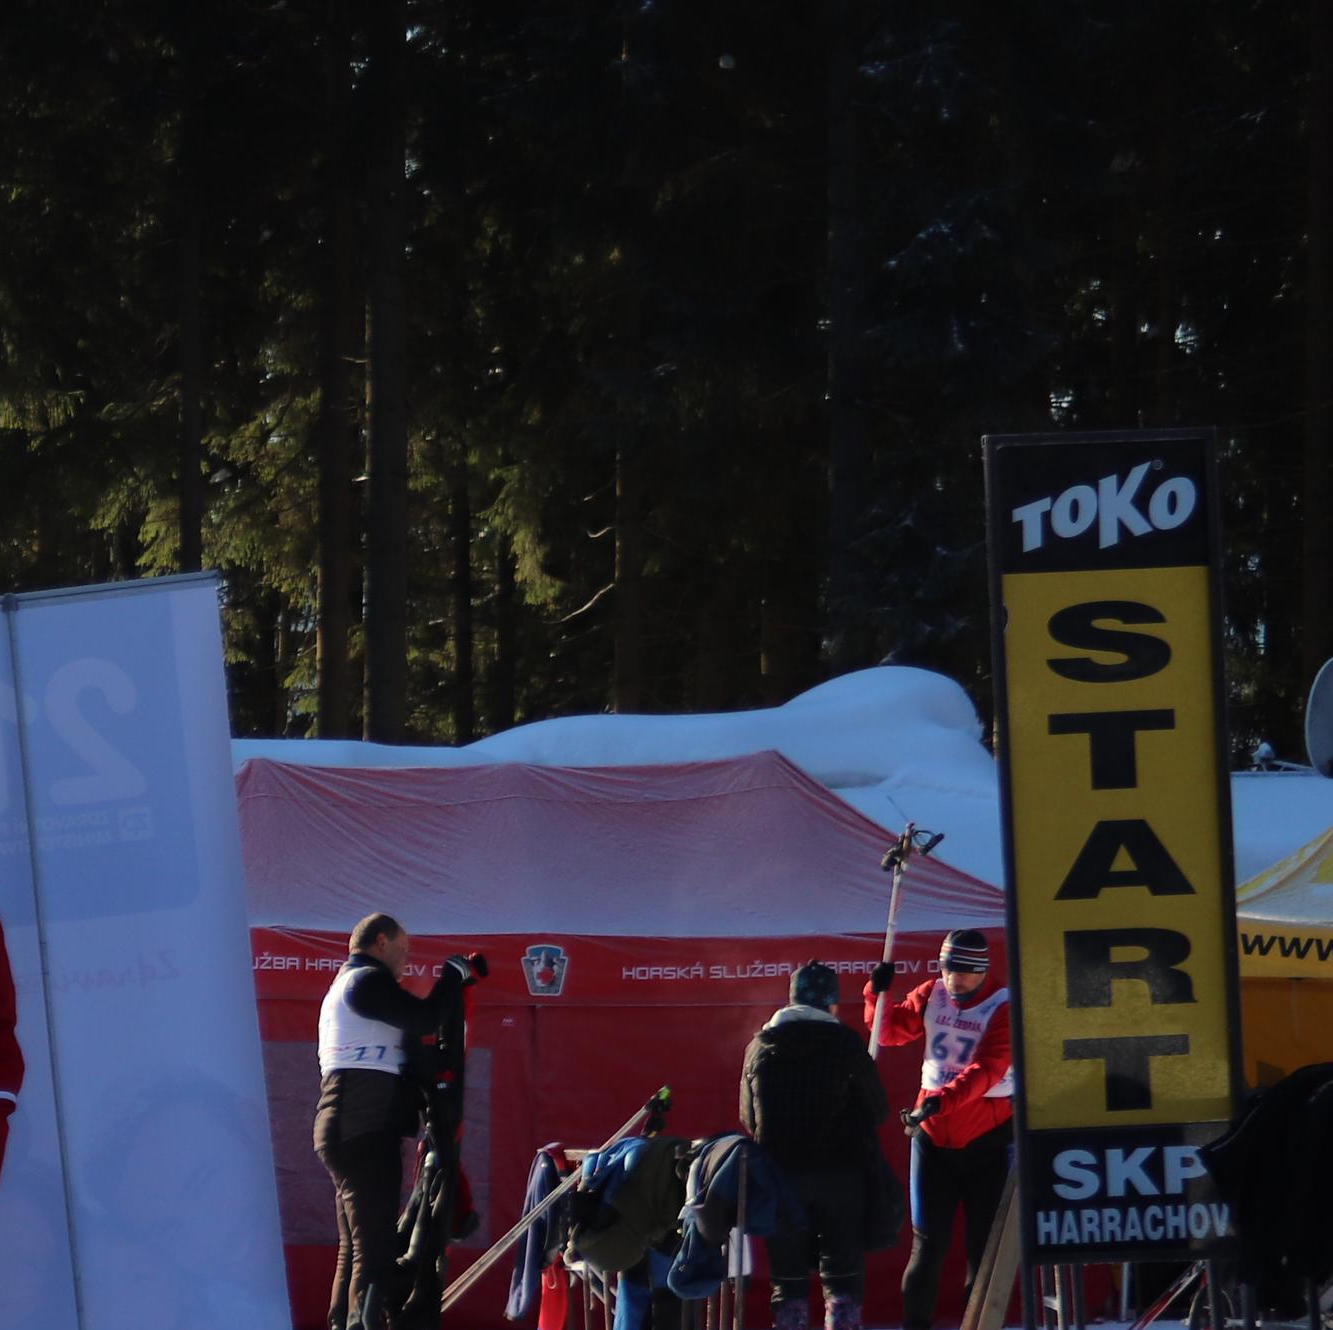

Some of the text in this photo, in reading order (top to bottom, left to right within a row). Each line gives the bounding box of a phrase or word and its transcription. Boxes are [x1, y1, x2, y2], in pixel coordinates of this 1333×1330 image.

[1012, 460, 1197, 553] TOKO
[1045, 599, 1199, 1112] START
[622, 961, 702, 980] HORSKÁ
[708, 957, 792, 980] SLUŽBA
[931, 1031, 975, 1063] 67
[1052, 1144, 1208, 1200] SKP
[1036, 1202, 1231, 1246] HARRACHOV
